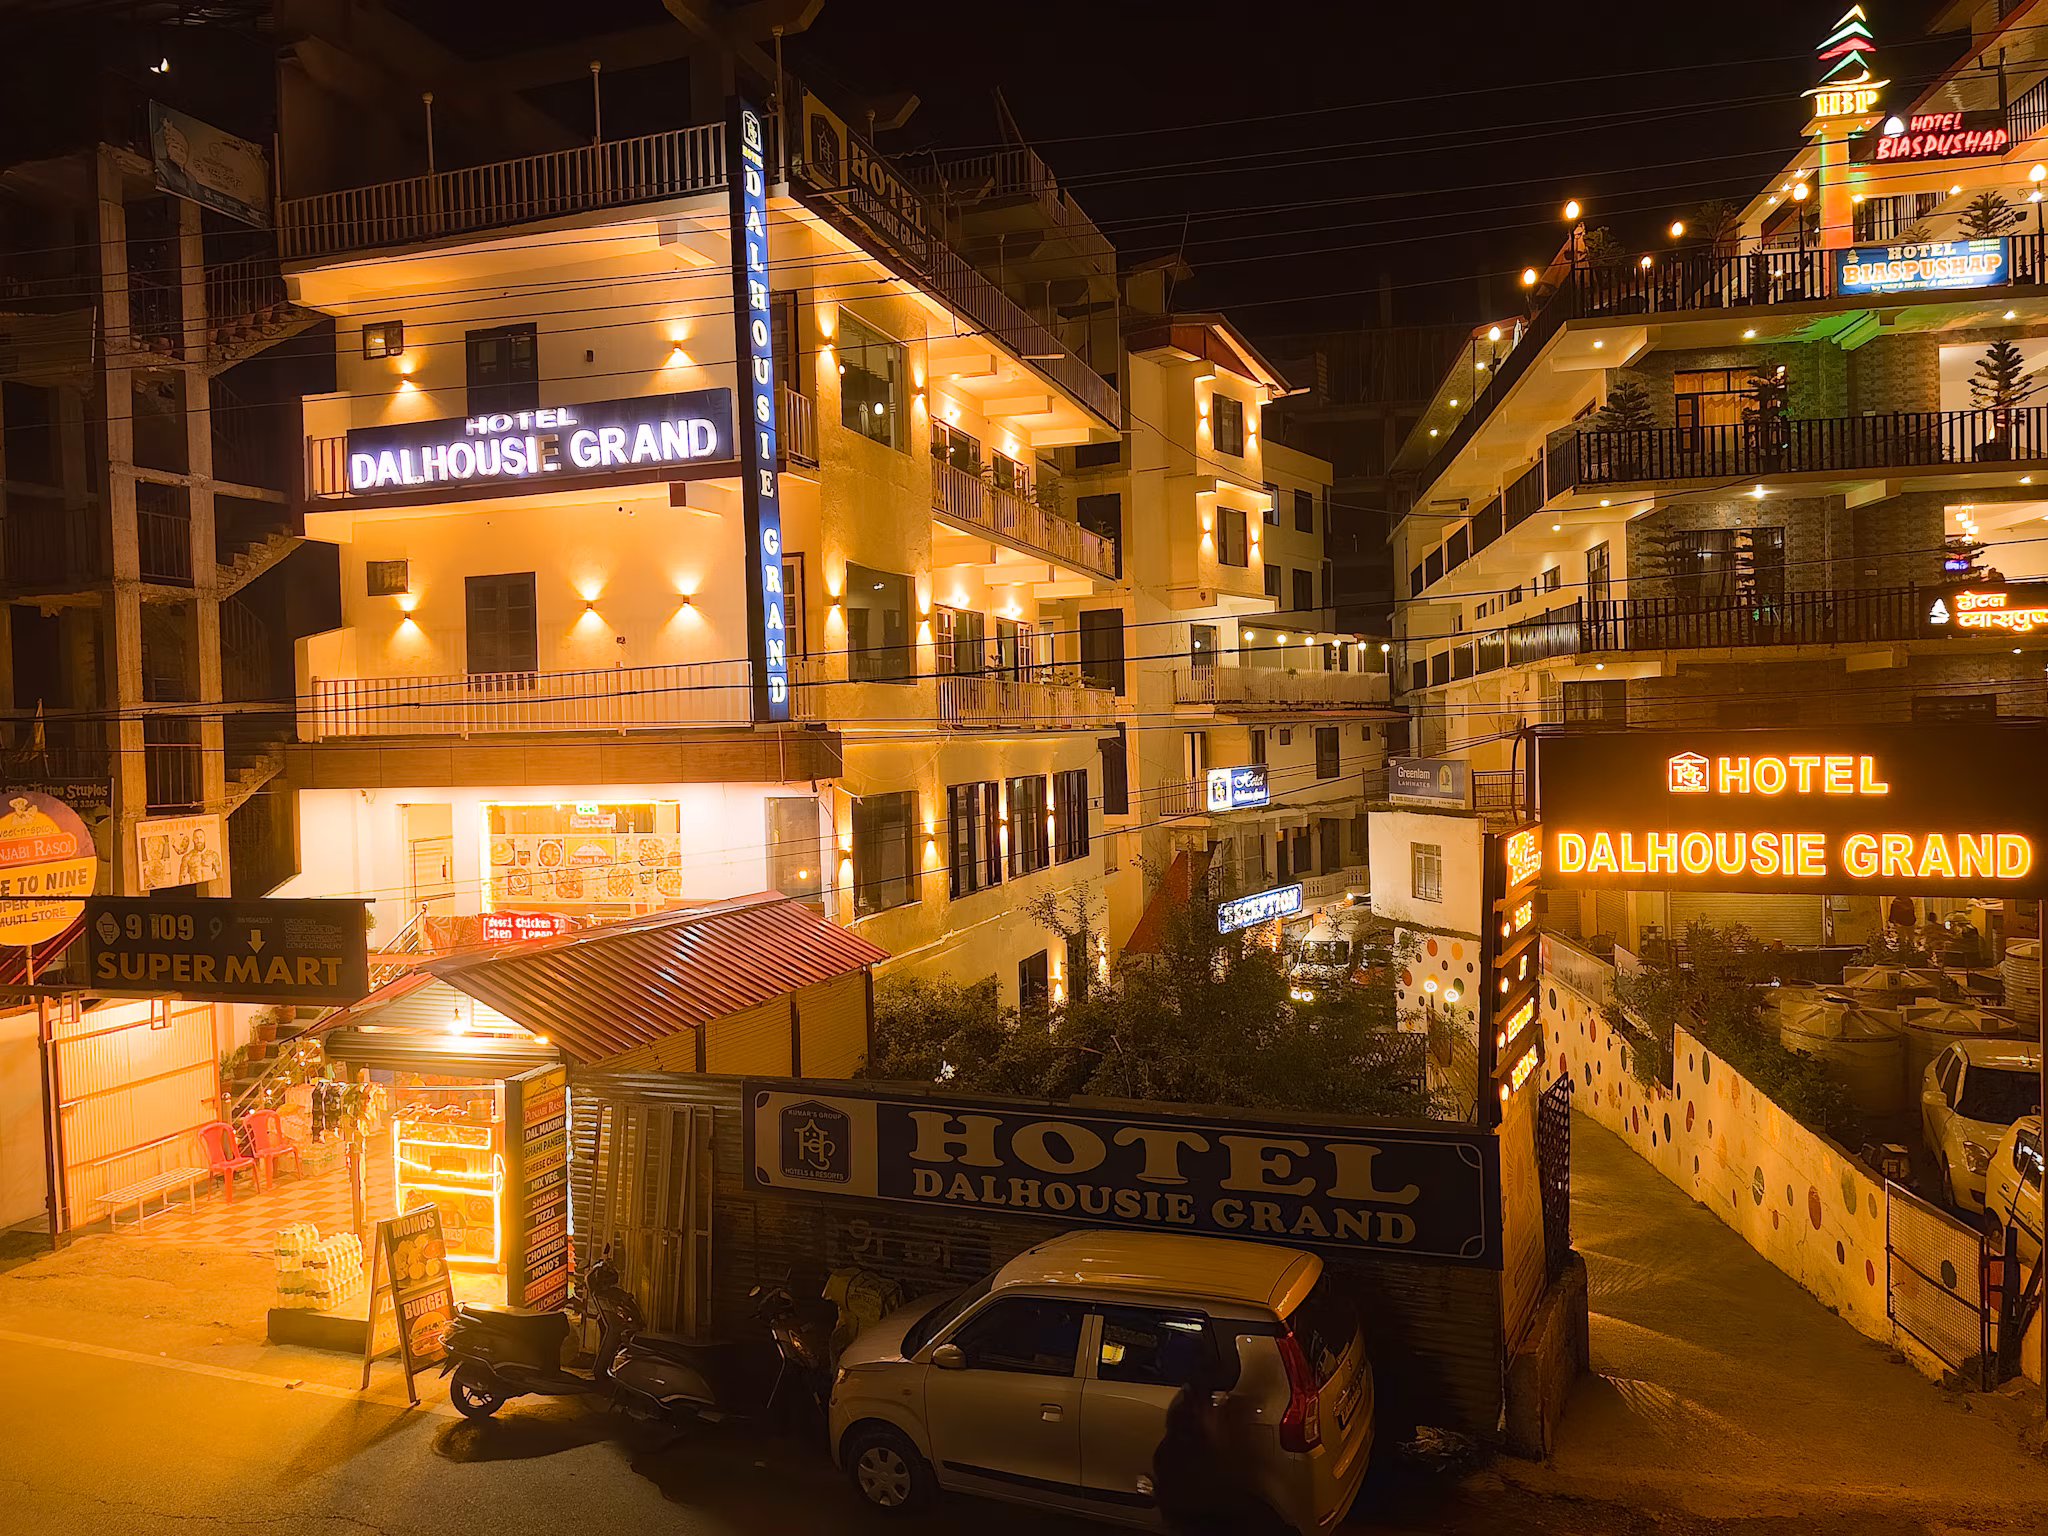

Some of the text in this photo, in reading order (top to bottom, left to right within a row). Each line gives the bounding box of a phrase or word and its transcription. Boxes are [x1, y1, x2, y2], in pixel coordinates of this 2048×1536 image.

[1815, 91, 1877, 117] HBP
[1910, 113, 1962, 132] HOTEL
[851, 141, 926, 235] HOTEL
[900, 221, 926, 261] GRAND
[1887, 243, 1956, 260] HOTEL
[1843, 254, 2002, 286] BIASPUSHAP
[745, 165, 774, 498] DALHOUSIE
[466, 407, 577, 436] HOTEL
[570, 418, 718, 468] GRAND
[351, 434, 562, 490] DALHOUSIE
[764, 528, 786, 703] GRAND
[1398, 766, 1430, 780] Greenlam
[1718, 756, 1888, 794] HOTEL
[34, 840, 72, 857] RASOI
[1558, 832, 1827, 876] DALHOUSIE
[1843, 834, 2032, 878] GRAND
[17, 875, 38, 895] TO
[46, 868, 87, 890] NINE
[32, 907, 66, 922] STORE
[126, 914, 142, 939] 9
[97, 952, 342, 985] SUPER MART
[788, 1109, 842, 1120] KUMAR'S GROUP
[525, 1133, 565, 1158] SHAHI PANEER
[526, 1127, 539, 1140] DAL
[525, 1151, 565, 1175] CHEESE CHILLY
[907, 1110, 1421, 1205] HOTEL
[531, 1178, 544, 1192] MIX
[785, 1167, 809, 1177] HOTELS
[815, 1171, 844, 1181] RESORTS
[532, 1189, 559, 1209] SHAKES
[912, 1168, 1417, 1245] DALHOUSIE GRAND
[392, 1212, 435, 1238] MOMOS
[535, 1208, 556, 1225] PIZZA
[531, 1223, 560, 1244] BURGER
[526, 1237, 565, 1264] CHOWMEIN
[532, 1257, 560, 1280] MOMO'S
[525, 1269, 567, 1301] BUTTER CHICKEN
[544, 1287, 566, 1307] CHICKEN
[403, 1290, 448, 1320] BURGER
